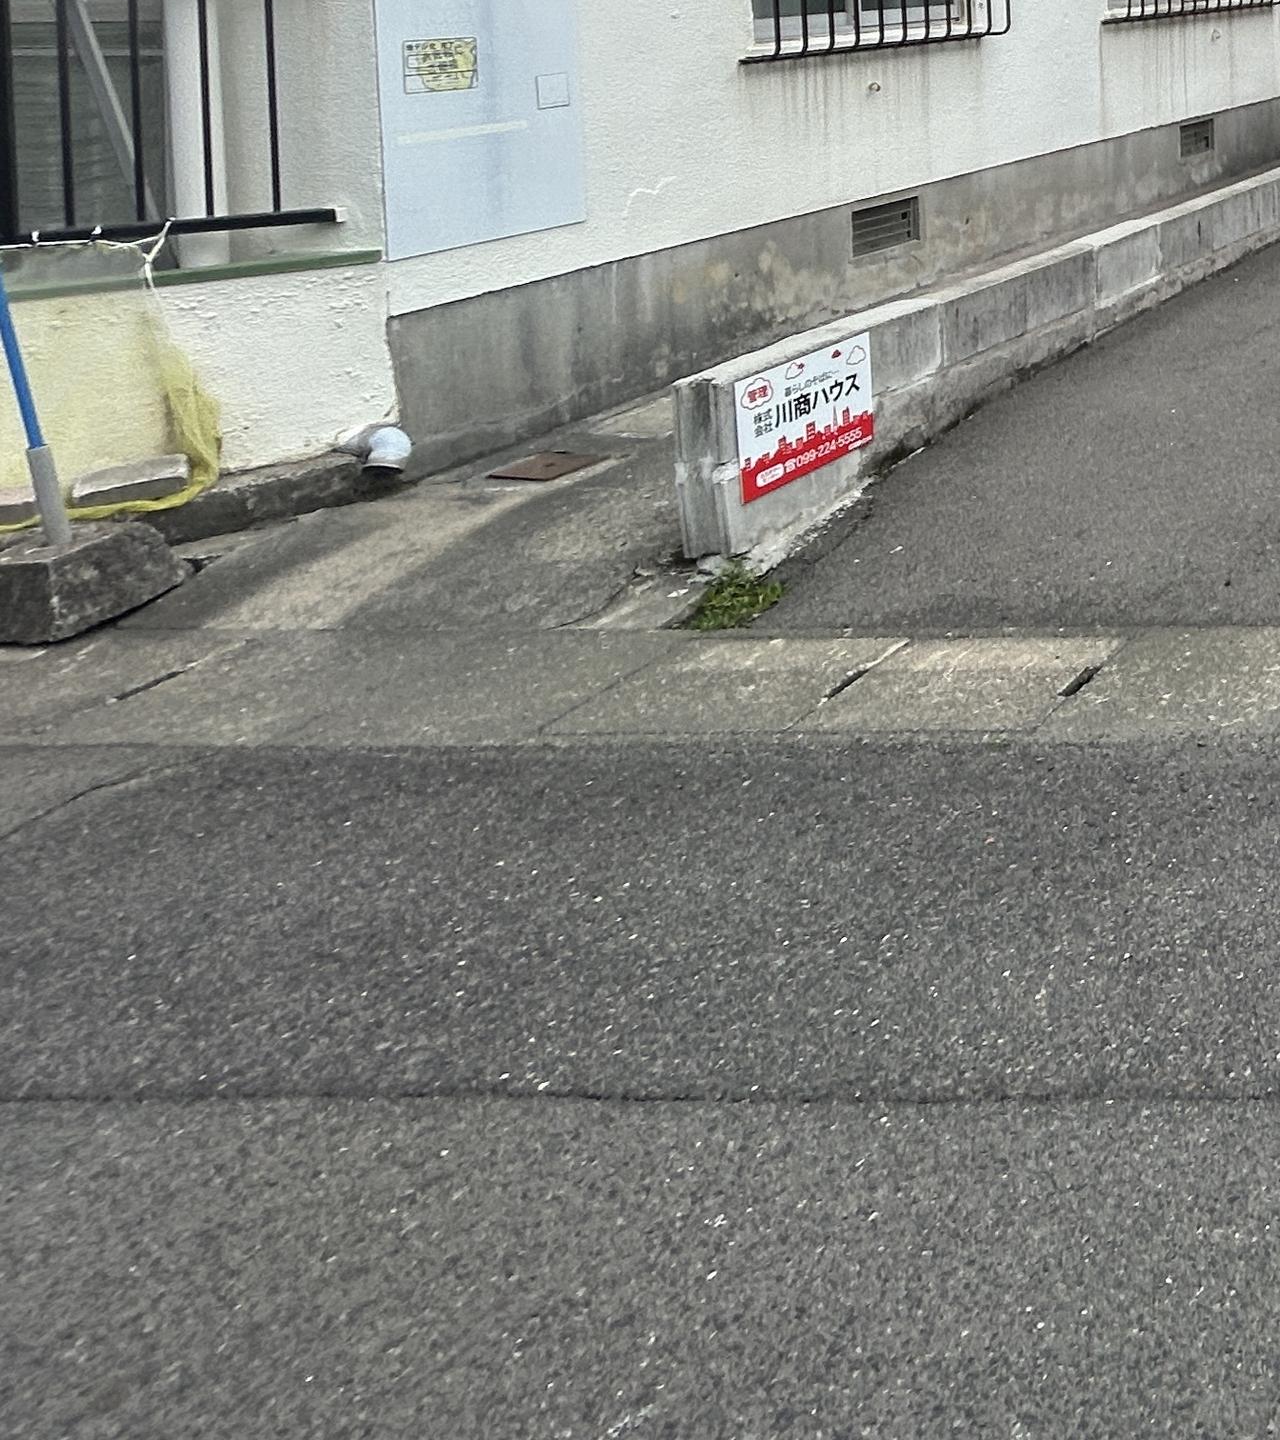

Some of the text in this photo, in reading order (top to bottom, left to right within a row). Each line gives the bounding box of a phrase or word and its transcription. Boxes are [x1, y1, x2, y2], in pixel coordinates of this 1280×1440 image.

[747, 385, 768, 403] 管理
[775, 373, 860, 428] 川商ハウス
[753, 408, 773, 425] 株式
[753, 423, 773, 438] 会社
[796, 427, 862, 468] 099-224-5555
